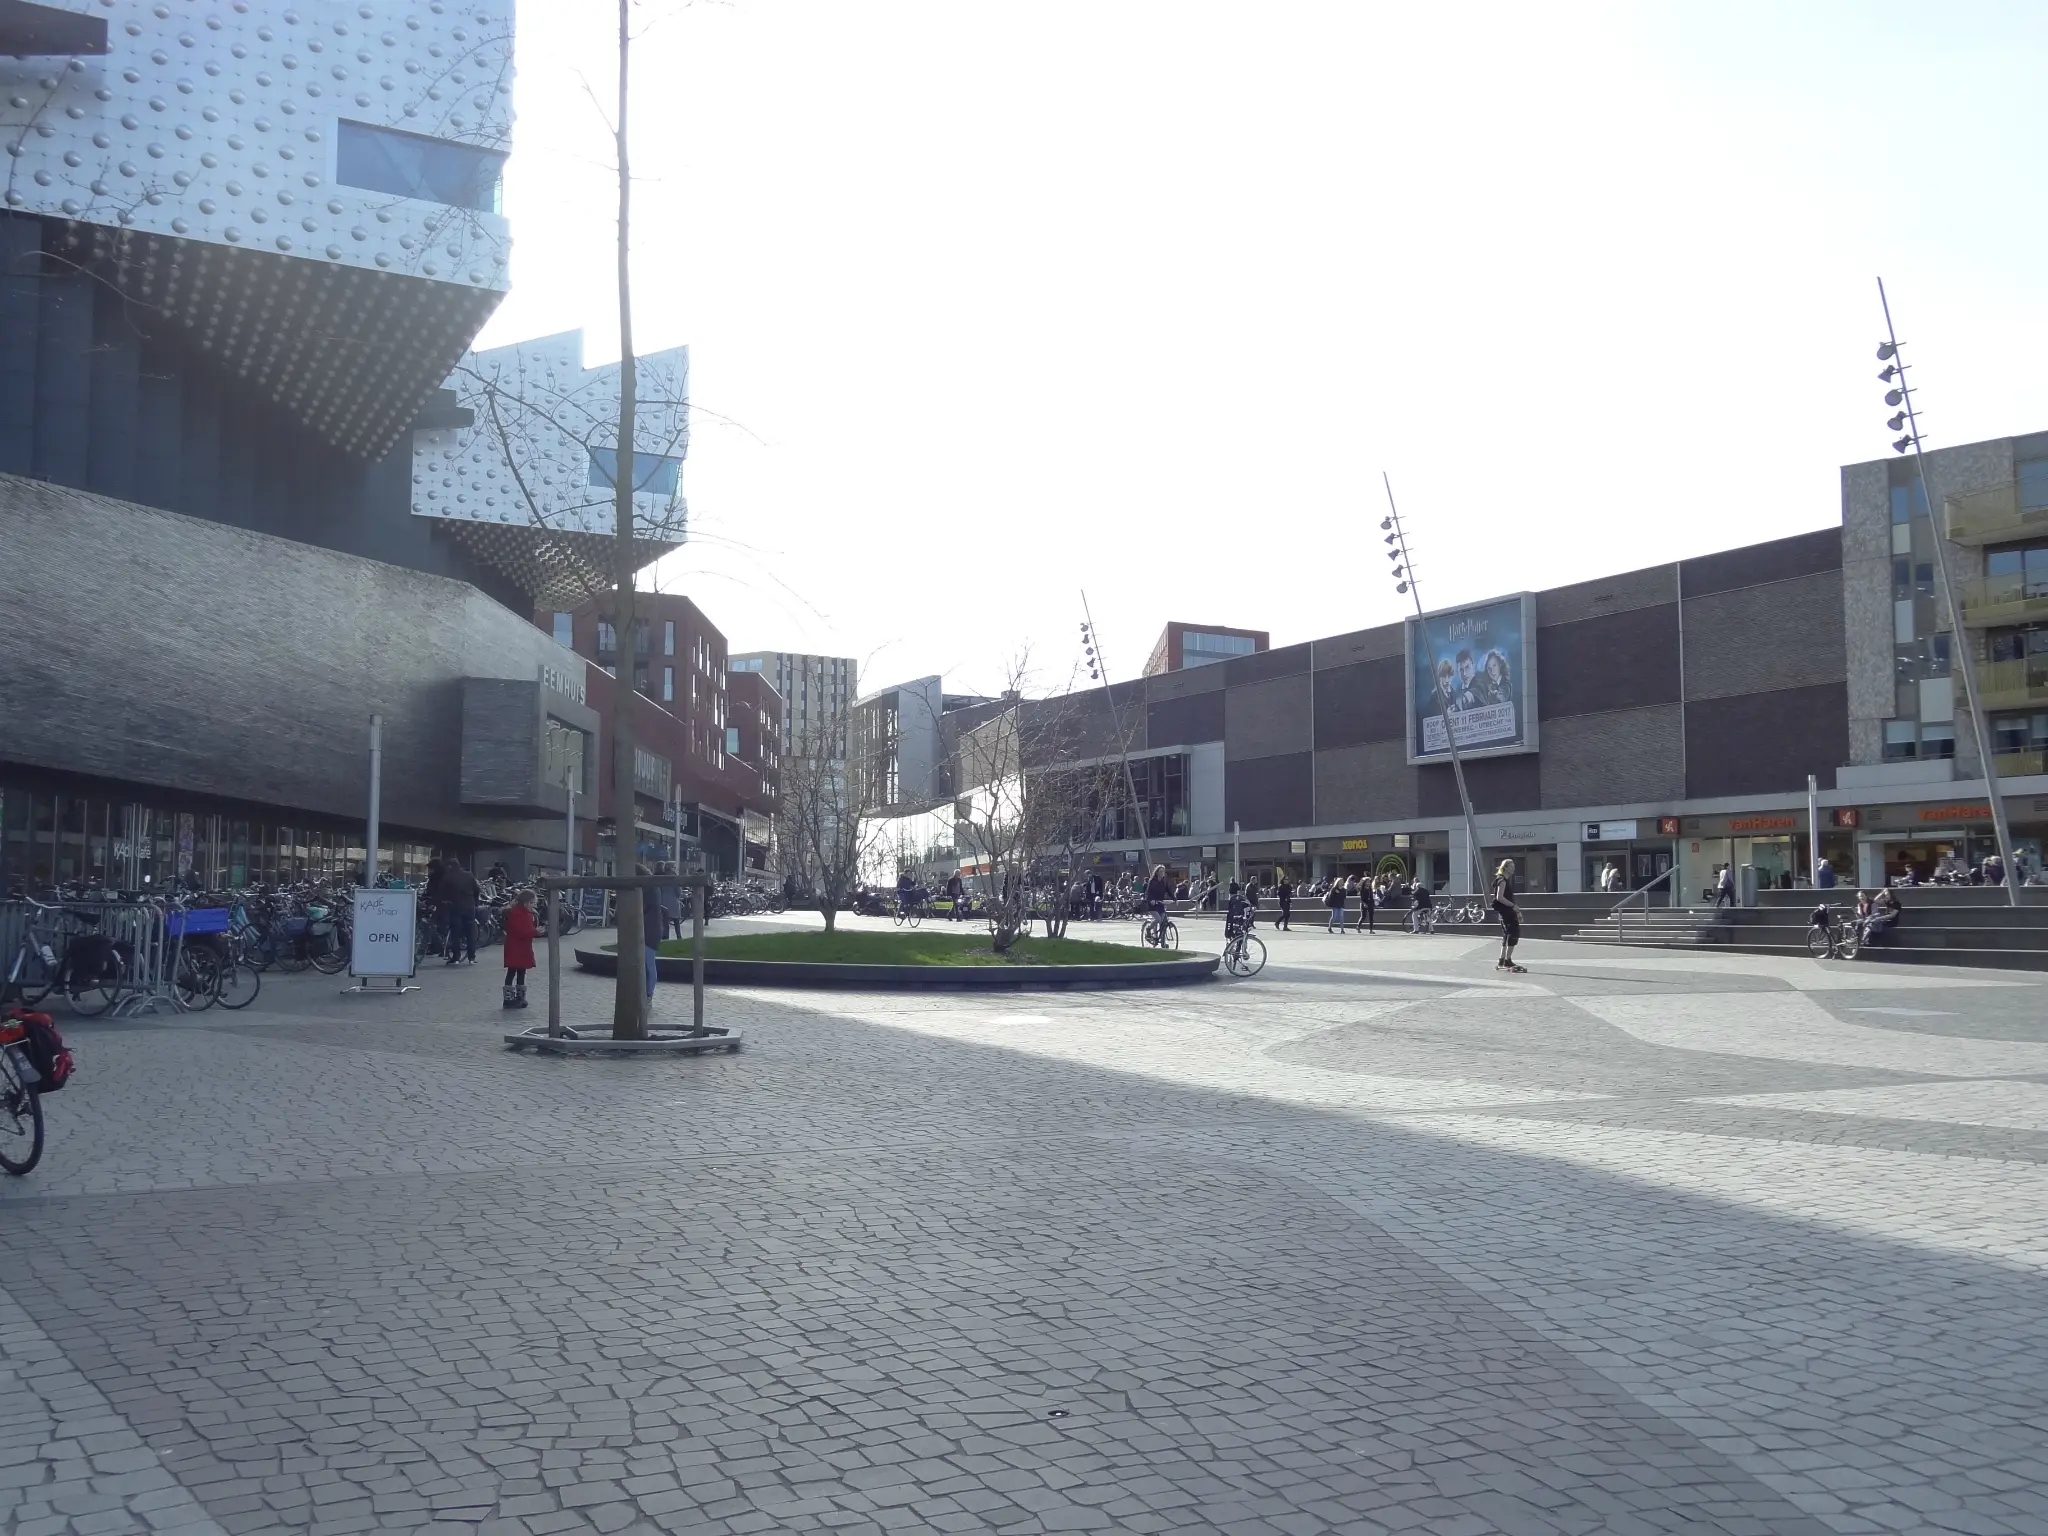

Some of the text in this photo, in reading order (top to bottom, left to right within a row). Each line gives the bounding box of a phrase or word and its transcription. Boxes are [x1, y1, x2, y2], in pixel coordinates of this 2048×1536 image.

[543, 665, 586, 706] EEMHUIS
[1468, 710, 1497, 723] FEBRUARI
[1478, 719, 1503, 729] UTRECHT
[1918, 805, 1990, 821] vanHare
[368, 933, 399, 943] OPEN
